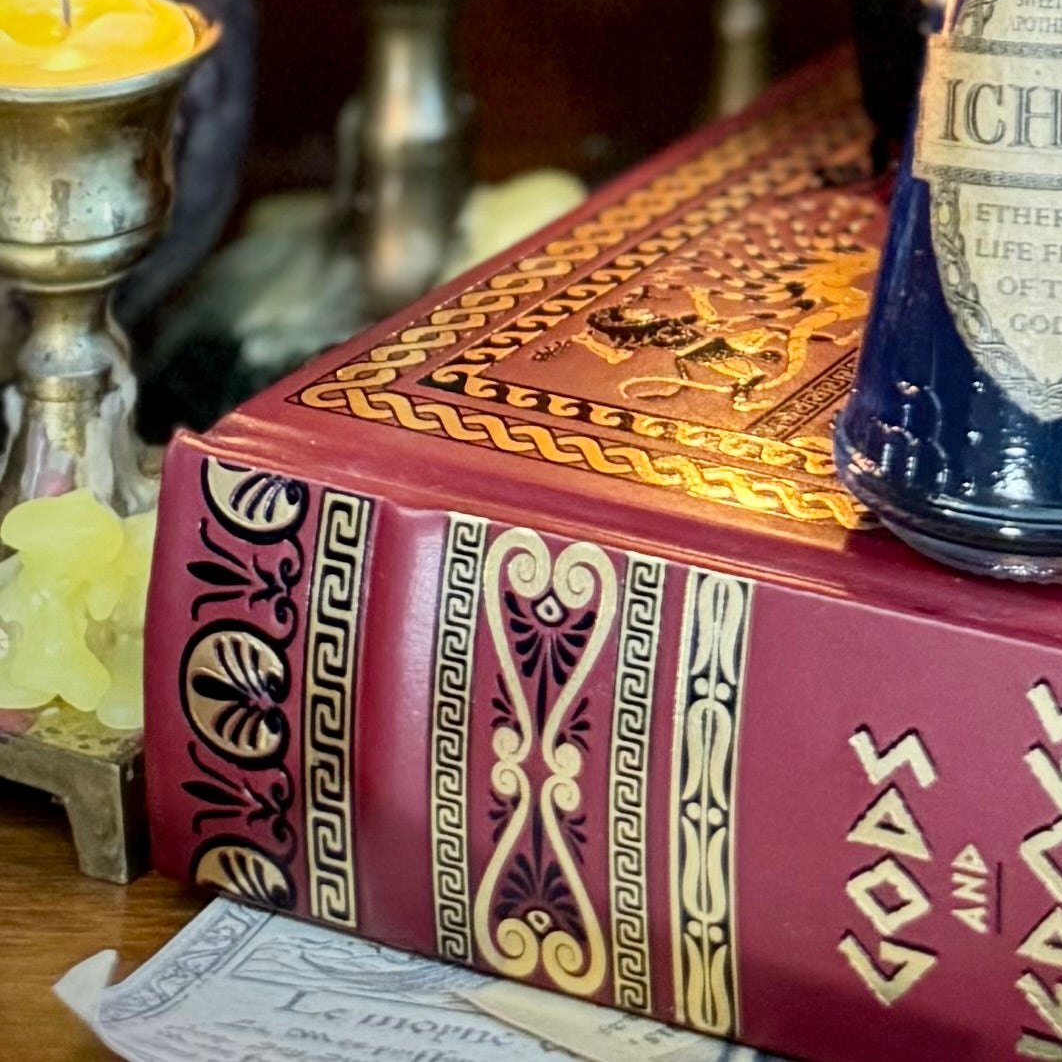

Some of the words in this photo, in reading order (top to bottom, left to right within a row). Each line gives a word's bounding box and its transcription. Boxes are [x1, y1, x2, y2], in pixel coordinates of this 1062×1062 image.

[975, 238, 1033, 262] LIFE
[997, 275, 1038, 297] OF
[836, 724, 939, 1008] GODS
[951, 844, 990, 934] AND
